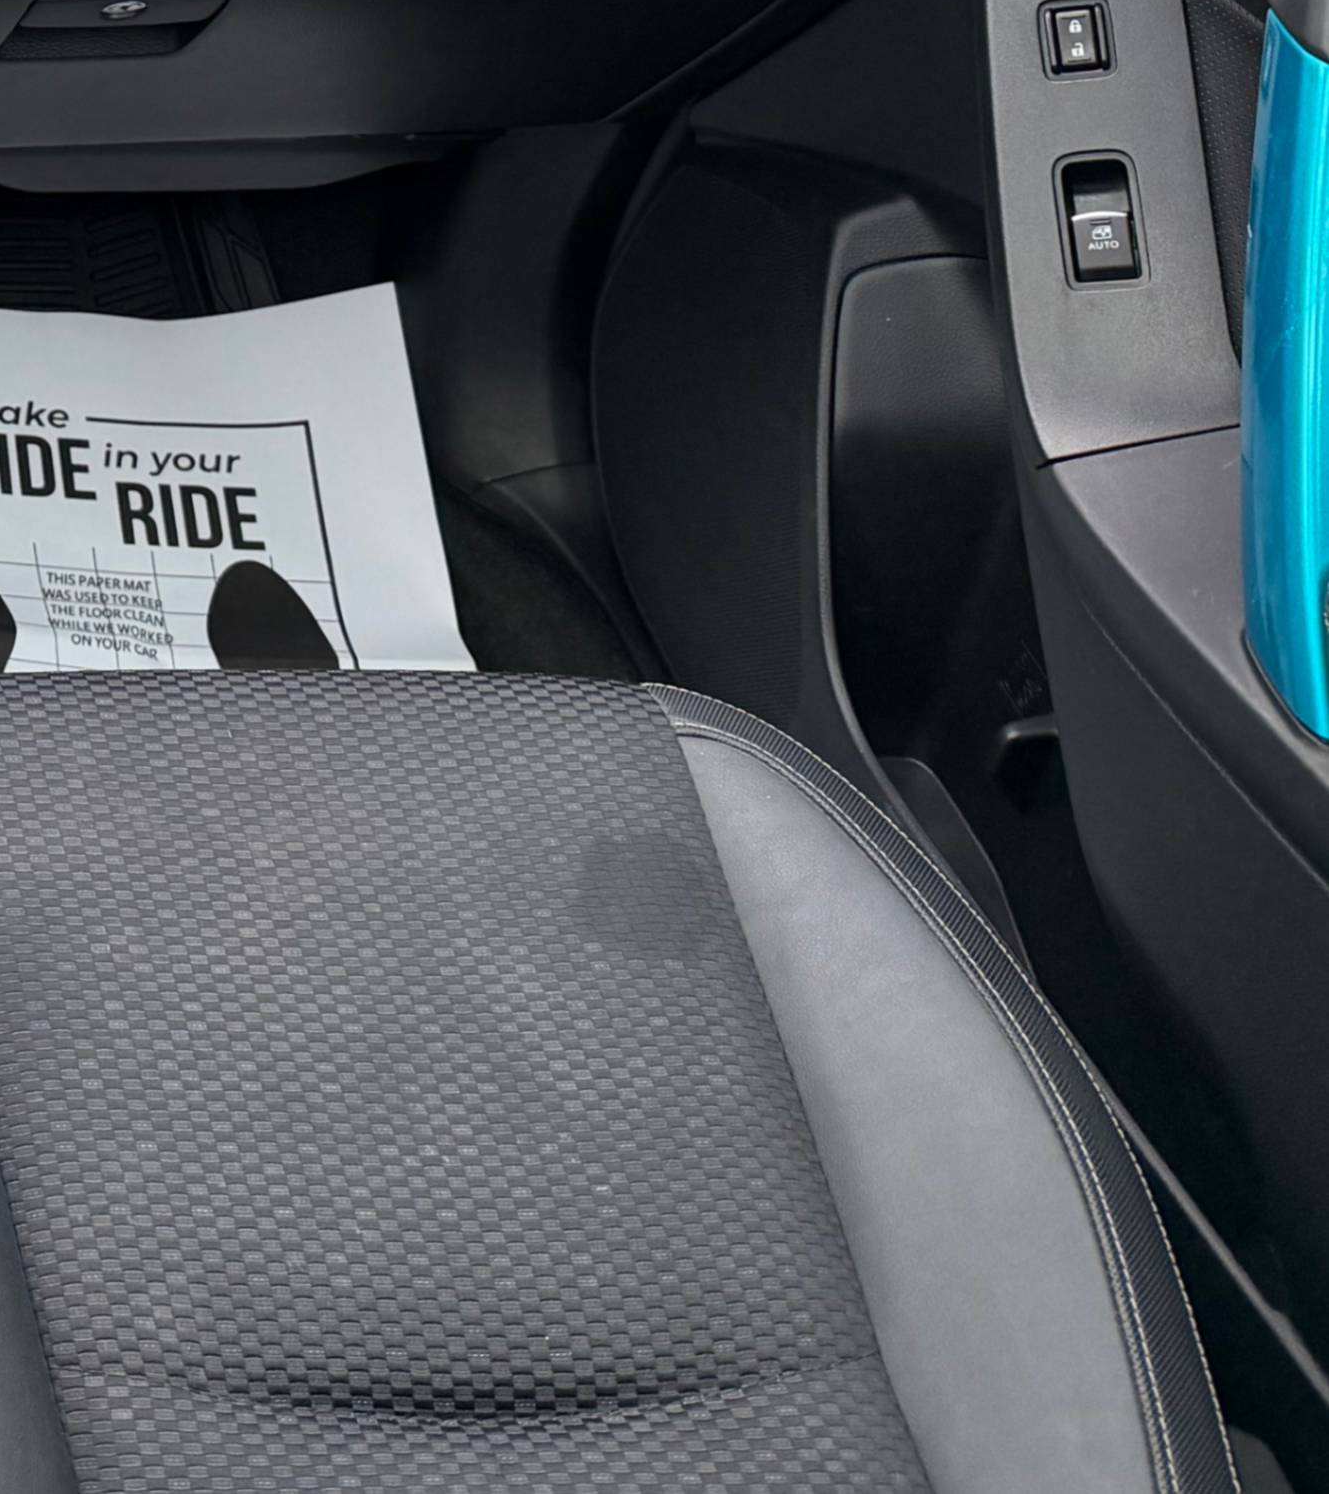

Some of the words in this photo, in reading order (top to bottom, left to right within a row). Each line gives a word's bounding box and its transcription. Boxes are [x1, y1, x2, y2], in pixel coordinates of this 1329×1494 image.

[1088, 239, 1120, 251] AUTO
[103, 442, 139, 469] in
[149, 451, 241, 476] your
[115, 481, 267, 551] RIDE
[46, 571, 76, 586] THIS
[78, 575, 121, 590] PAPER
[123, 579, 152, 592] MAT
[42, 587, 71, 601] WAS
[75, 590, 109, 604] USED
[111, 593, 129, 606] TO
[132, 595, 162, 611] KEEP
[50, 604, 76, 616] THE
[78, 606, 122, 619] FLOOR
[123, 609, 164, 627] CLEAN
[48, 617, 90, 632] WHILE
[93, 622, 114, 635] WE
[116, 624, 174, 645] WORKED
[70, 633, 92, 646] ON
[94, 636, 131, 652] YOUR
[134, 643, 158, 661] CAR
